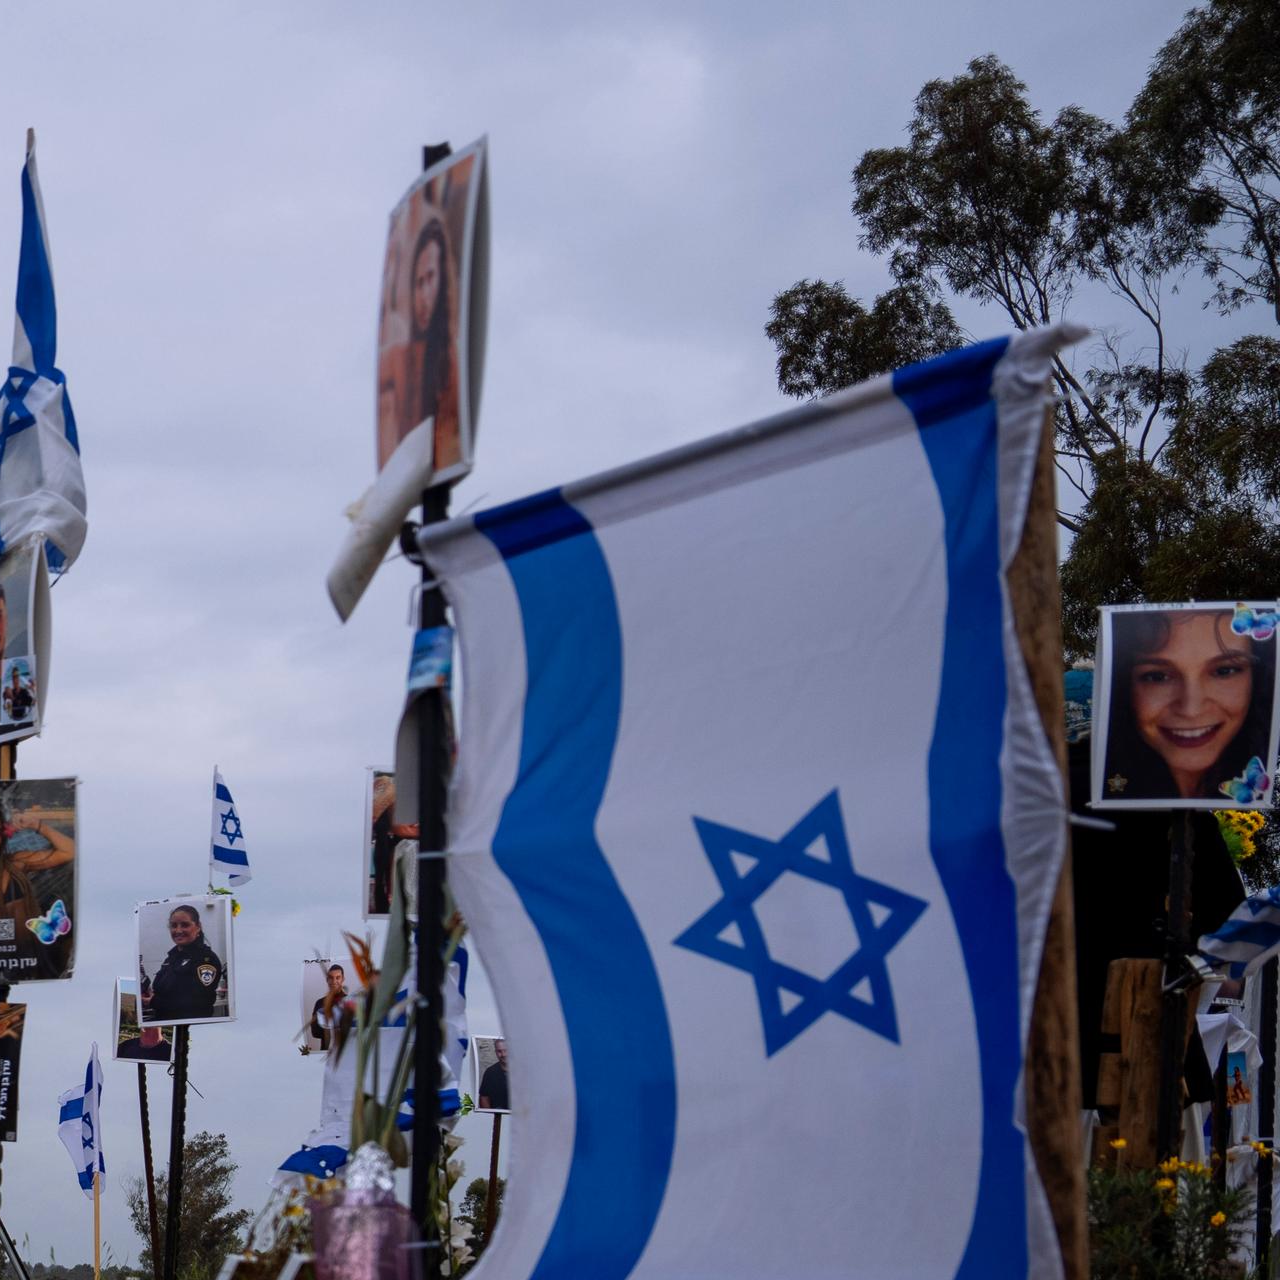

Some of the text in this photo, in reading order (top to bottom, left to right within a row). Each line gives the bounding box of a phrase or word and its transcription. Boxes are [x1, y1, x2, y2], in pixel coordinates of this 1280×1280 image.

[9, 958, 19, 969] בן
[20, 957, 38, 969] עדן
[3, 1059, 11, 1075] עדן
[1, 1077, 10, 1086] בן
